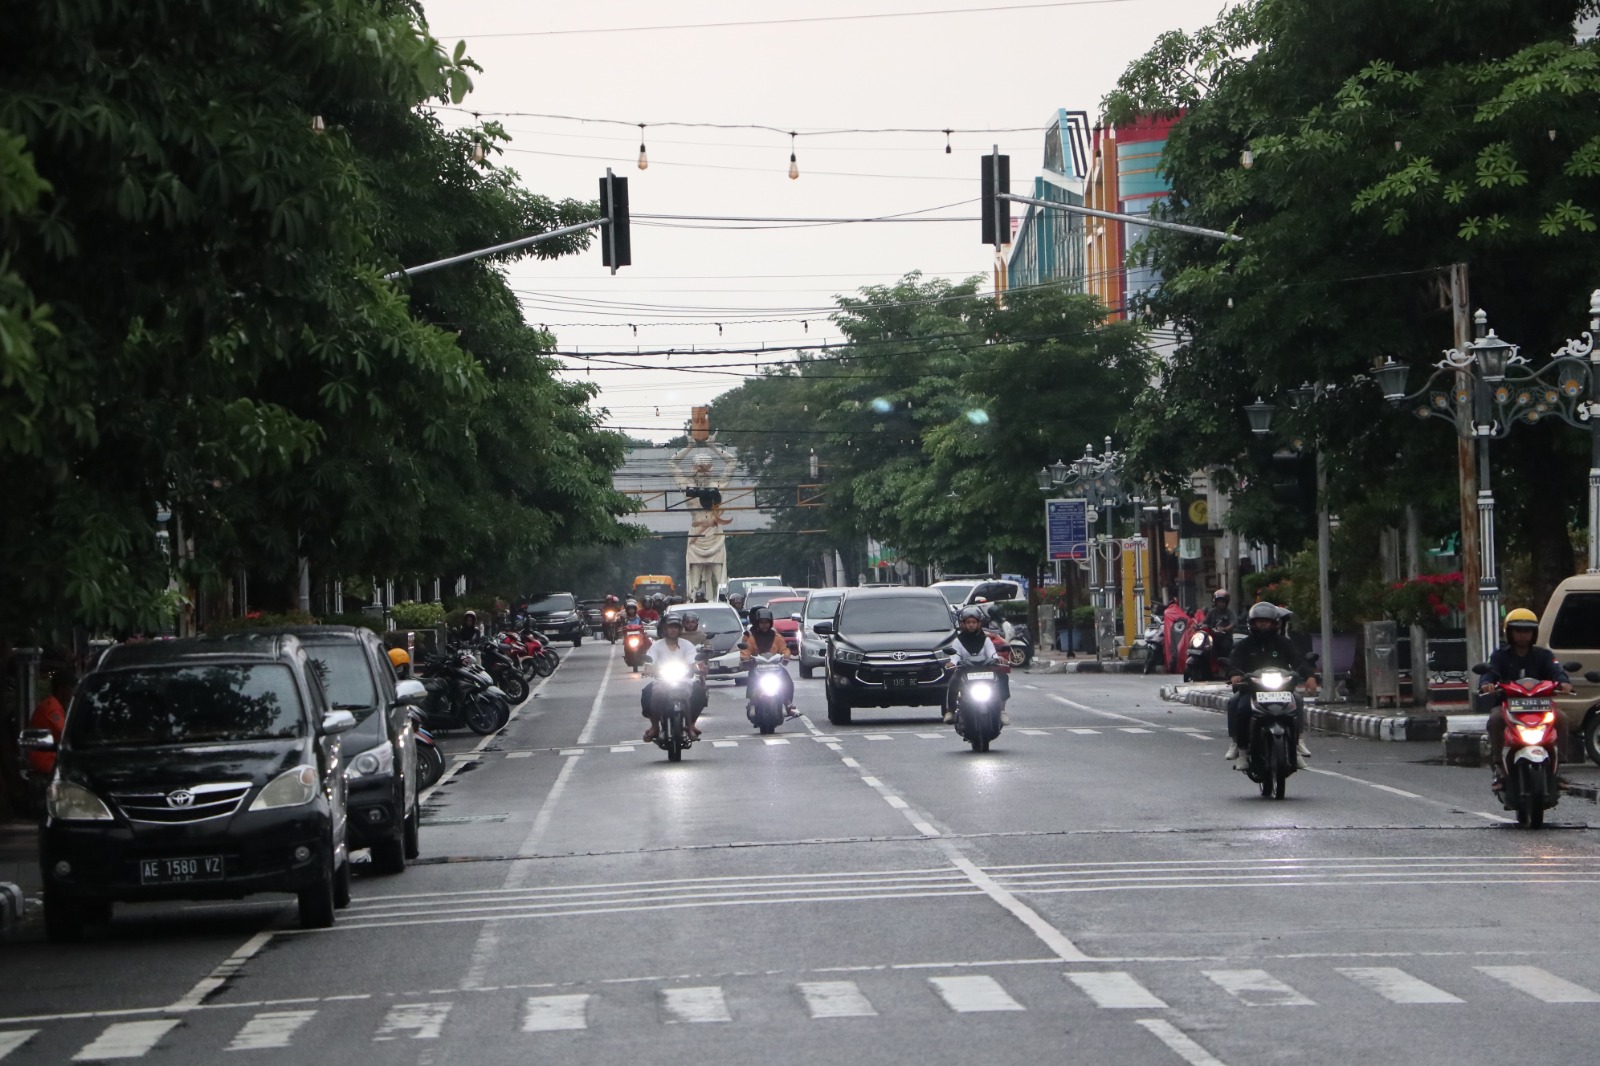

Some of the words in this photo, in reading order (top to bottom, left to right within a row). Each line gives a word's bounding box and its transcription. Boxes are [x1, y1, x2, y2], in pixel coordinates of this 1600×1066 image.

[144, 862, 159, 877] AE
[166, 859, 197, 876] 1580
[205, 857, 220, 873] VZ
